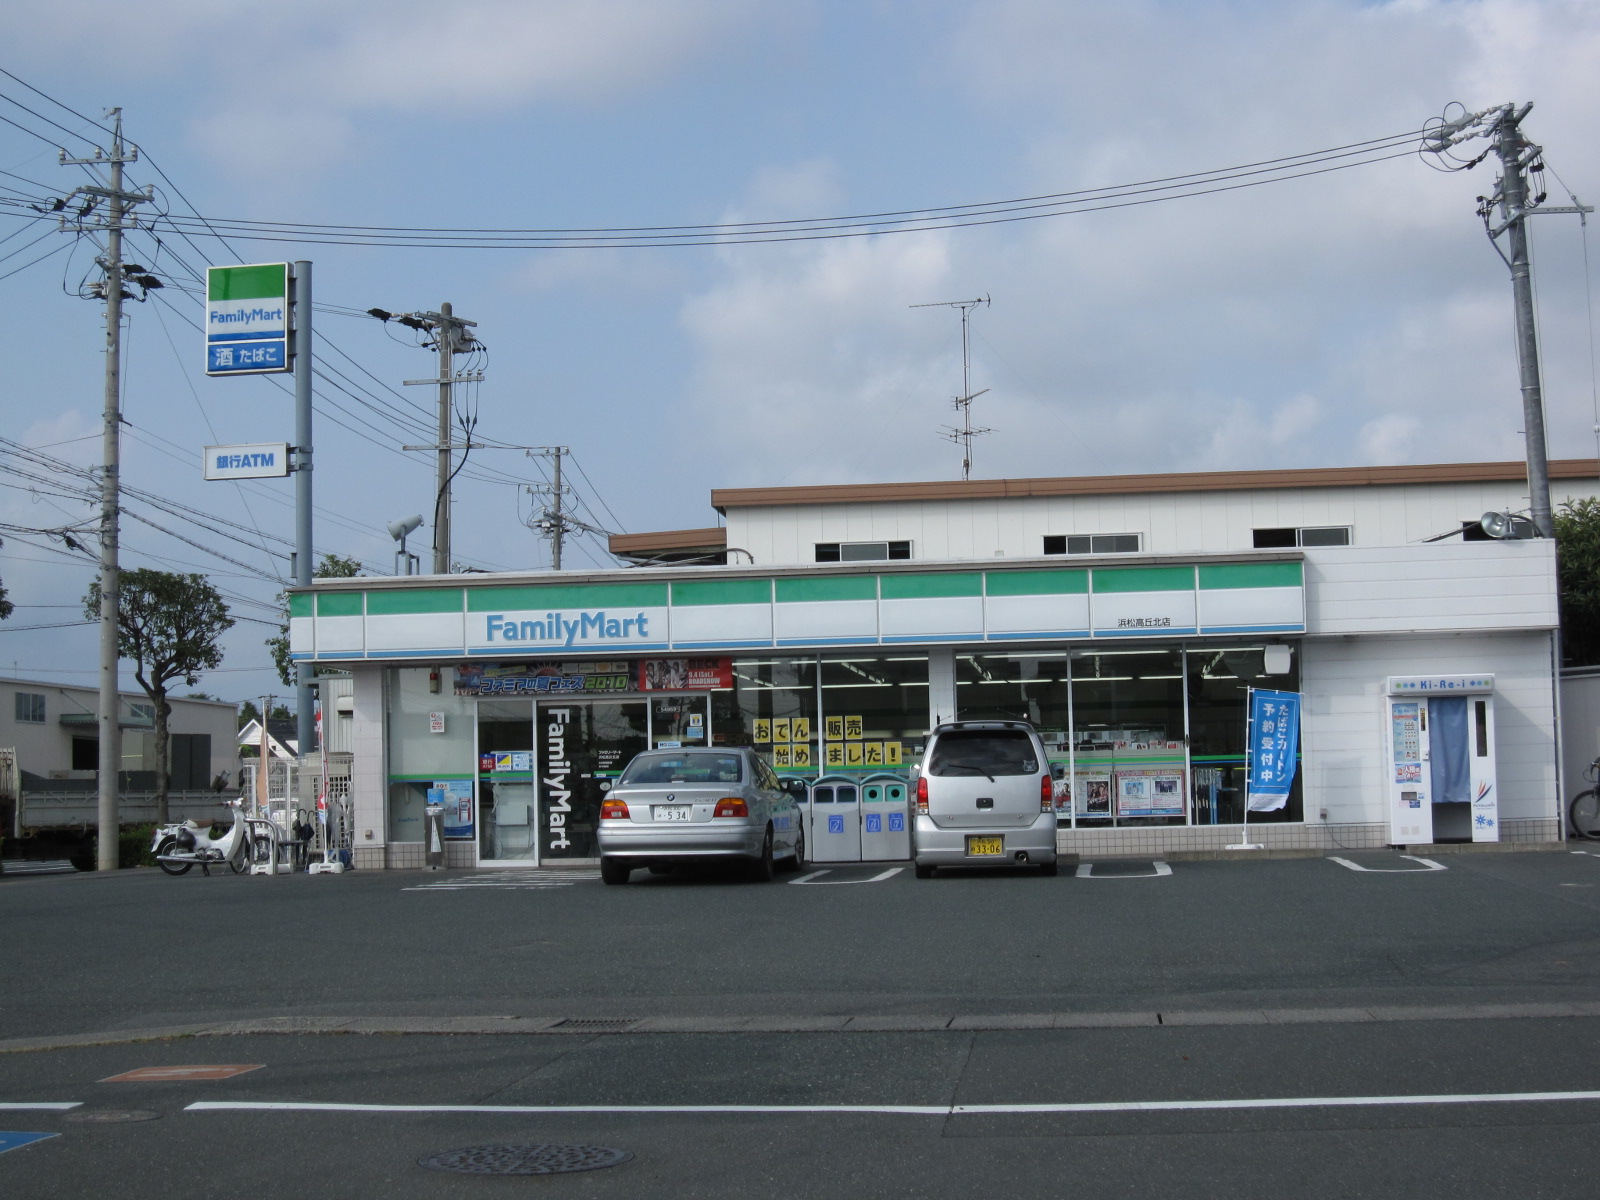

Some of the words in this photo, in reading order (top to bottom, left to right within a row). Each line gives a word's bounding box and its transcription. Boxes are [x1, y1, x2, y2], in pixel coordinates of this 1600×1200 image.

[210, 308, 282, 325] FamilyMart
[216, 347, 233, 366] 酒
[240, 347, 277, 363] たばこ
[217, 453, 274, 469] 銀行ATM
[486, 611, 649, 646] FamilyMart
[1117, 617, 1171, 628] 浜松高丘北店
[754, 723, 808, 739] おでん
[828, 719, 861, 736] 販売
[1261, 703, 1276, 782] 予約受付中
[1276, 704, 1289, 782] たばこカートン
[775, 748, 808, 765] 始め
[543, 708, 572, 849] FamilyMart
